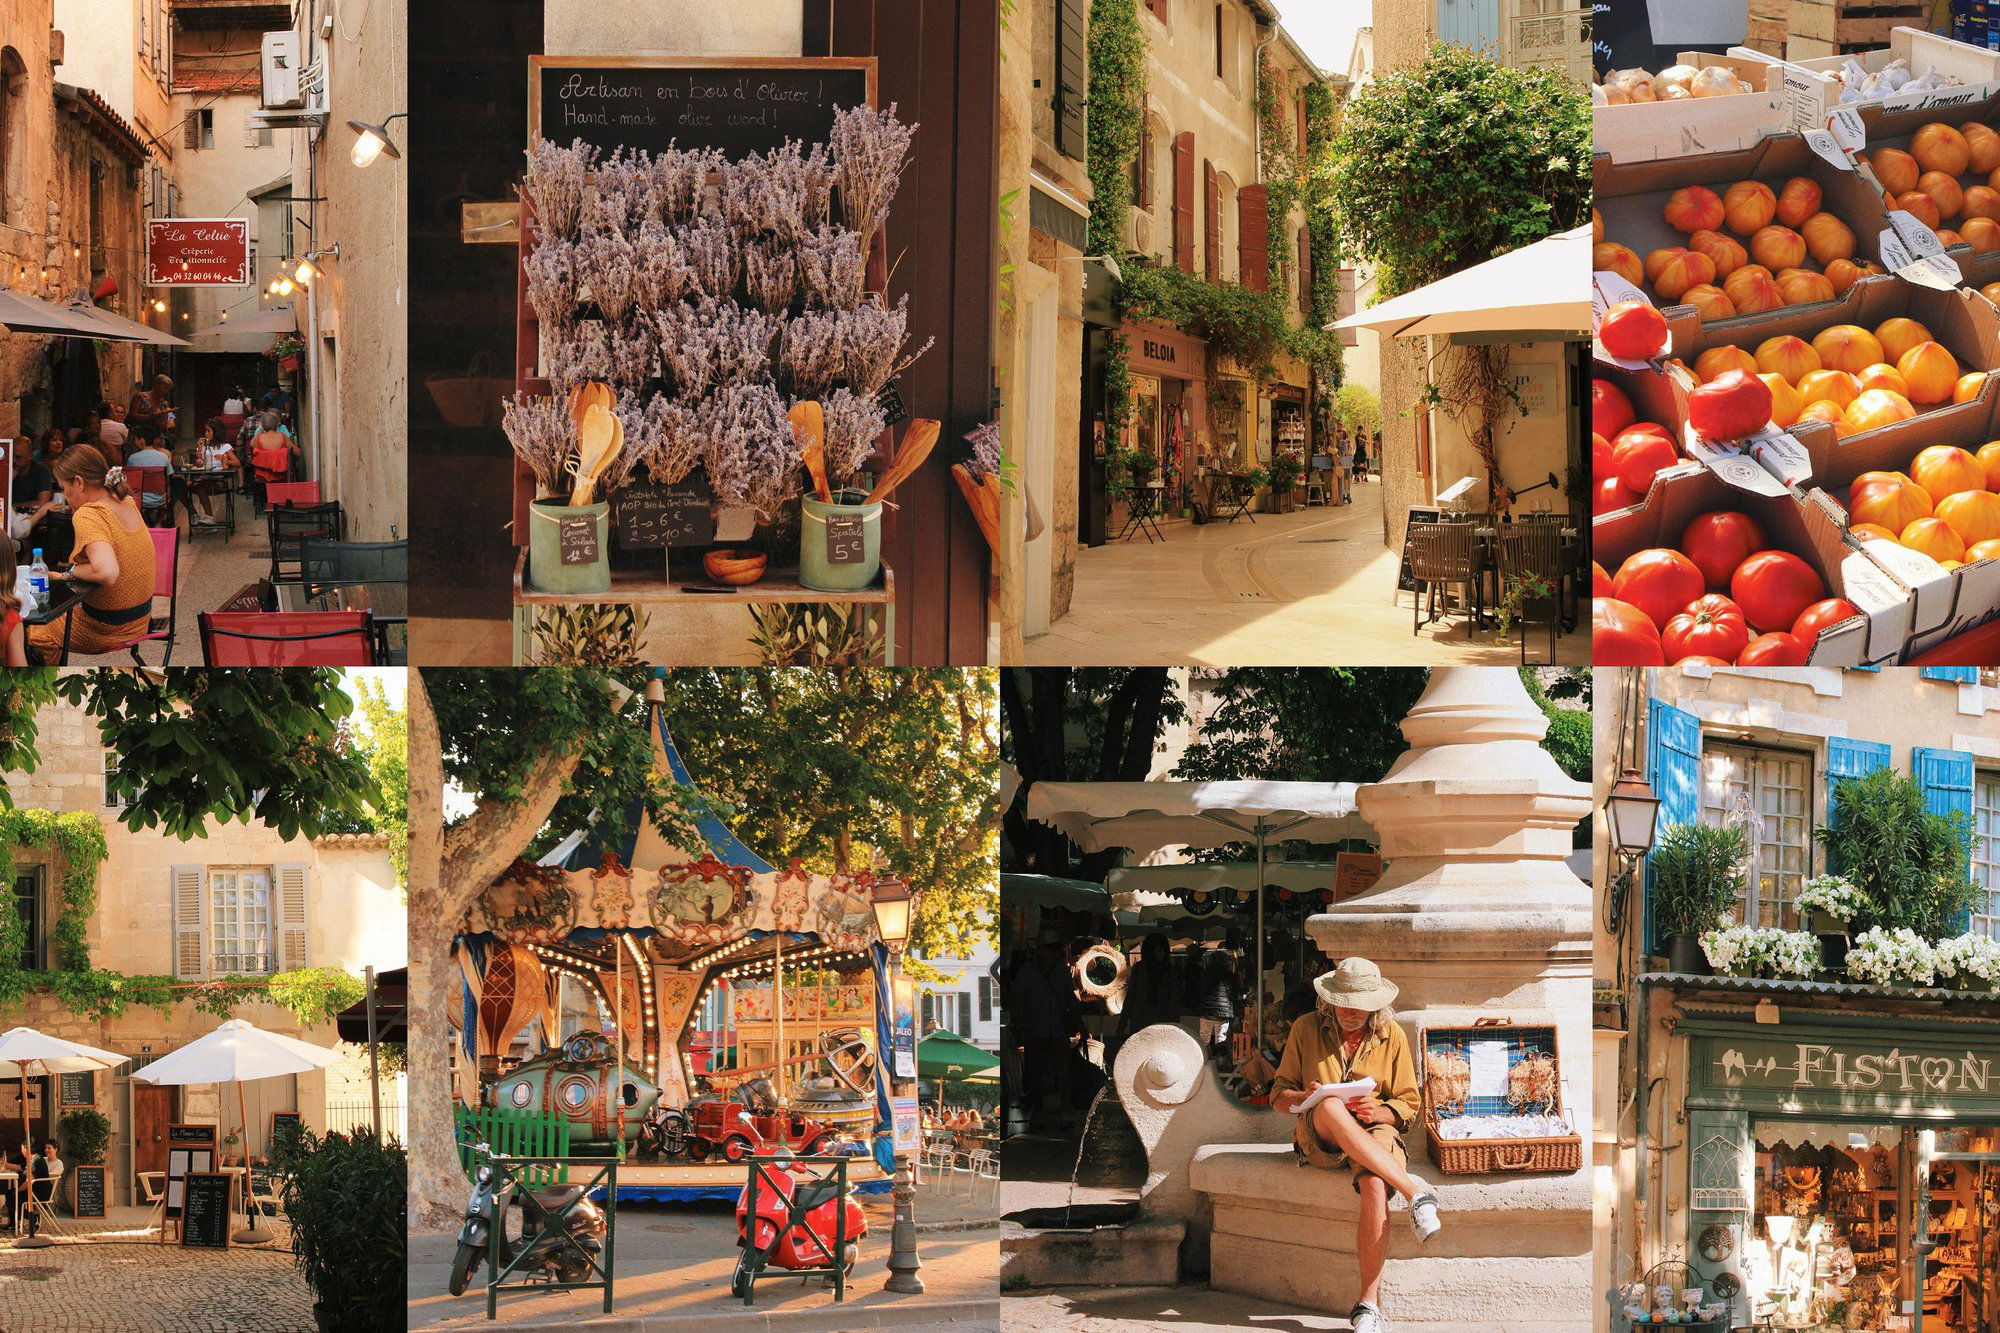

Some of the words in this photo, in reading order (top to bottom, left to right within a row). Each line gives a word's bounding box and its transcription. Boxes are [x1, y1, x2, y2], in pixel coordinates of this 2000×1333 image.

[560, 73, 643, 99] Artisan
[657, 87, 680, 99] en
[689, 76, 728, 99] bois
[678, 104, 713, 126] olive
[164, 230, 187, 242] La
[193, 228, 230, 241] Celtie
[173, 272, 182, 280] 04
[184, 272, 192, 280] 32
[193, 272, 202, 280] 60
[203, 272, 212, 280] 04
[213, 272, 222, 280] 46
[621, 501, 641, 511] AOP
[629, 515, 639, 528] 1
[659, 512, 668, 526] 6
[661, 529, 680, 540] 10
[829, 526, 864, 541] Spatule
[835, 544, 848, 560] 5
